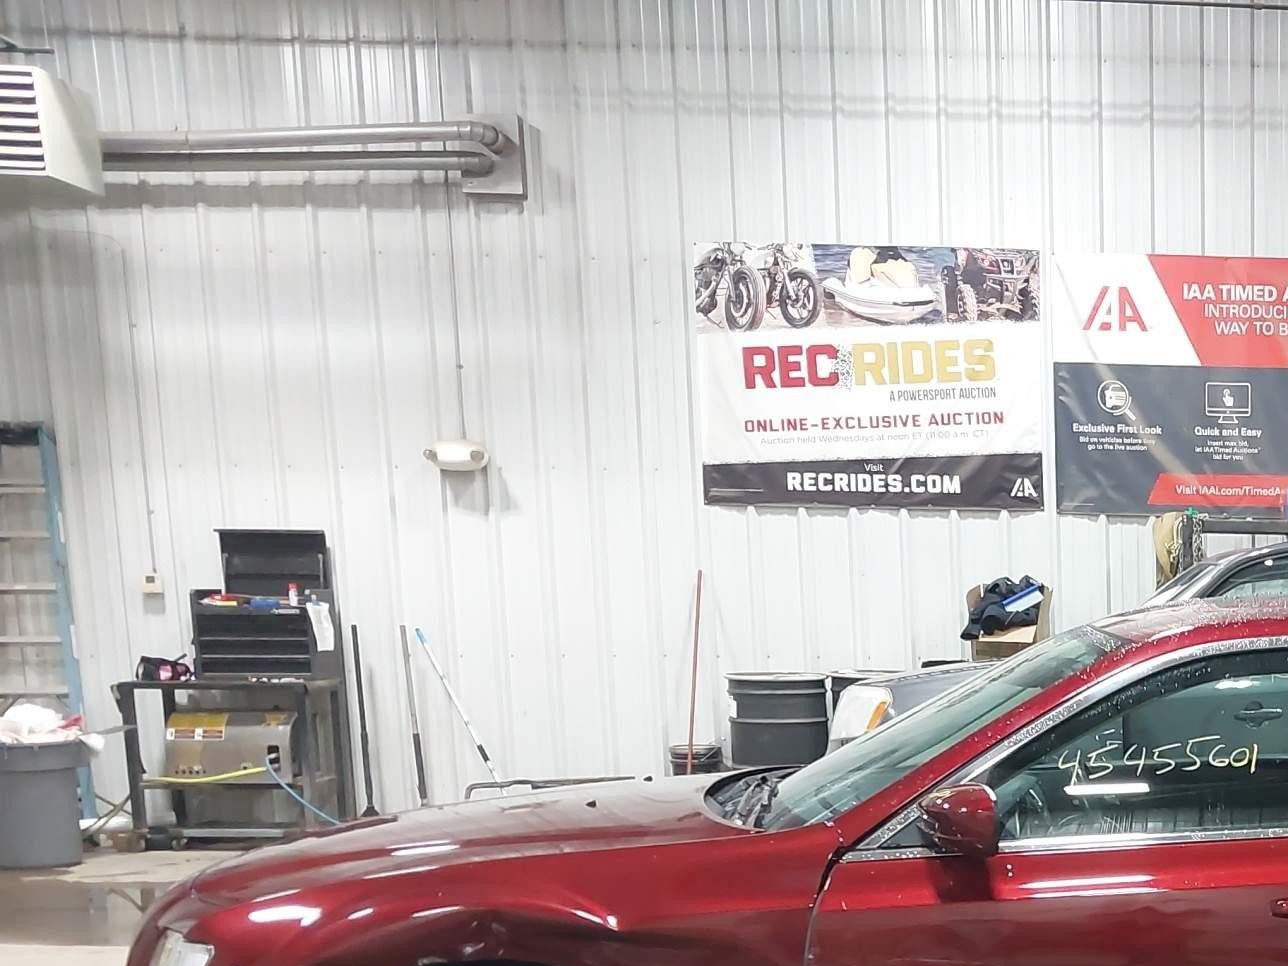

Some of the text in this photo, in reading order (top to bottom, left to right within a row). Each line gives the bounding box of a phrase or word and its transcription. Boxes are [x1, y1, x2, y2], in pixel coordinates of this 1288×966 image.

[1183, 283, 1216, 300] IAA
[1219, 285, 1277, 302] TIMED
[1215, 321, 1249, 335] WAY
[1253, 322, 1274, 335] TO
[742, 339, 996, 389] REC RIDES
[889, 387, 996, 402] A POWERSPORT AUCTION
[744, 411, 1004, 433] ONLINE-EXCLUSIVE AUCTION
[1073, 423, 1162, 434] Exclusive First Look
[819, 434, 874, 442] Wednesdays
[912, 432, 922, 440] ET
[1195, 426, 1262, 438] Quick and Easy
[864, 463, 884, 472] Visit
[787, 472, 961, 494] RECRIDES.COM
[1176, 485, 1281, 496] Visit IAAI.com/TimedA
[1057, 735, 1258, 786] 45455601
